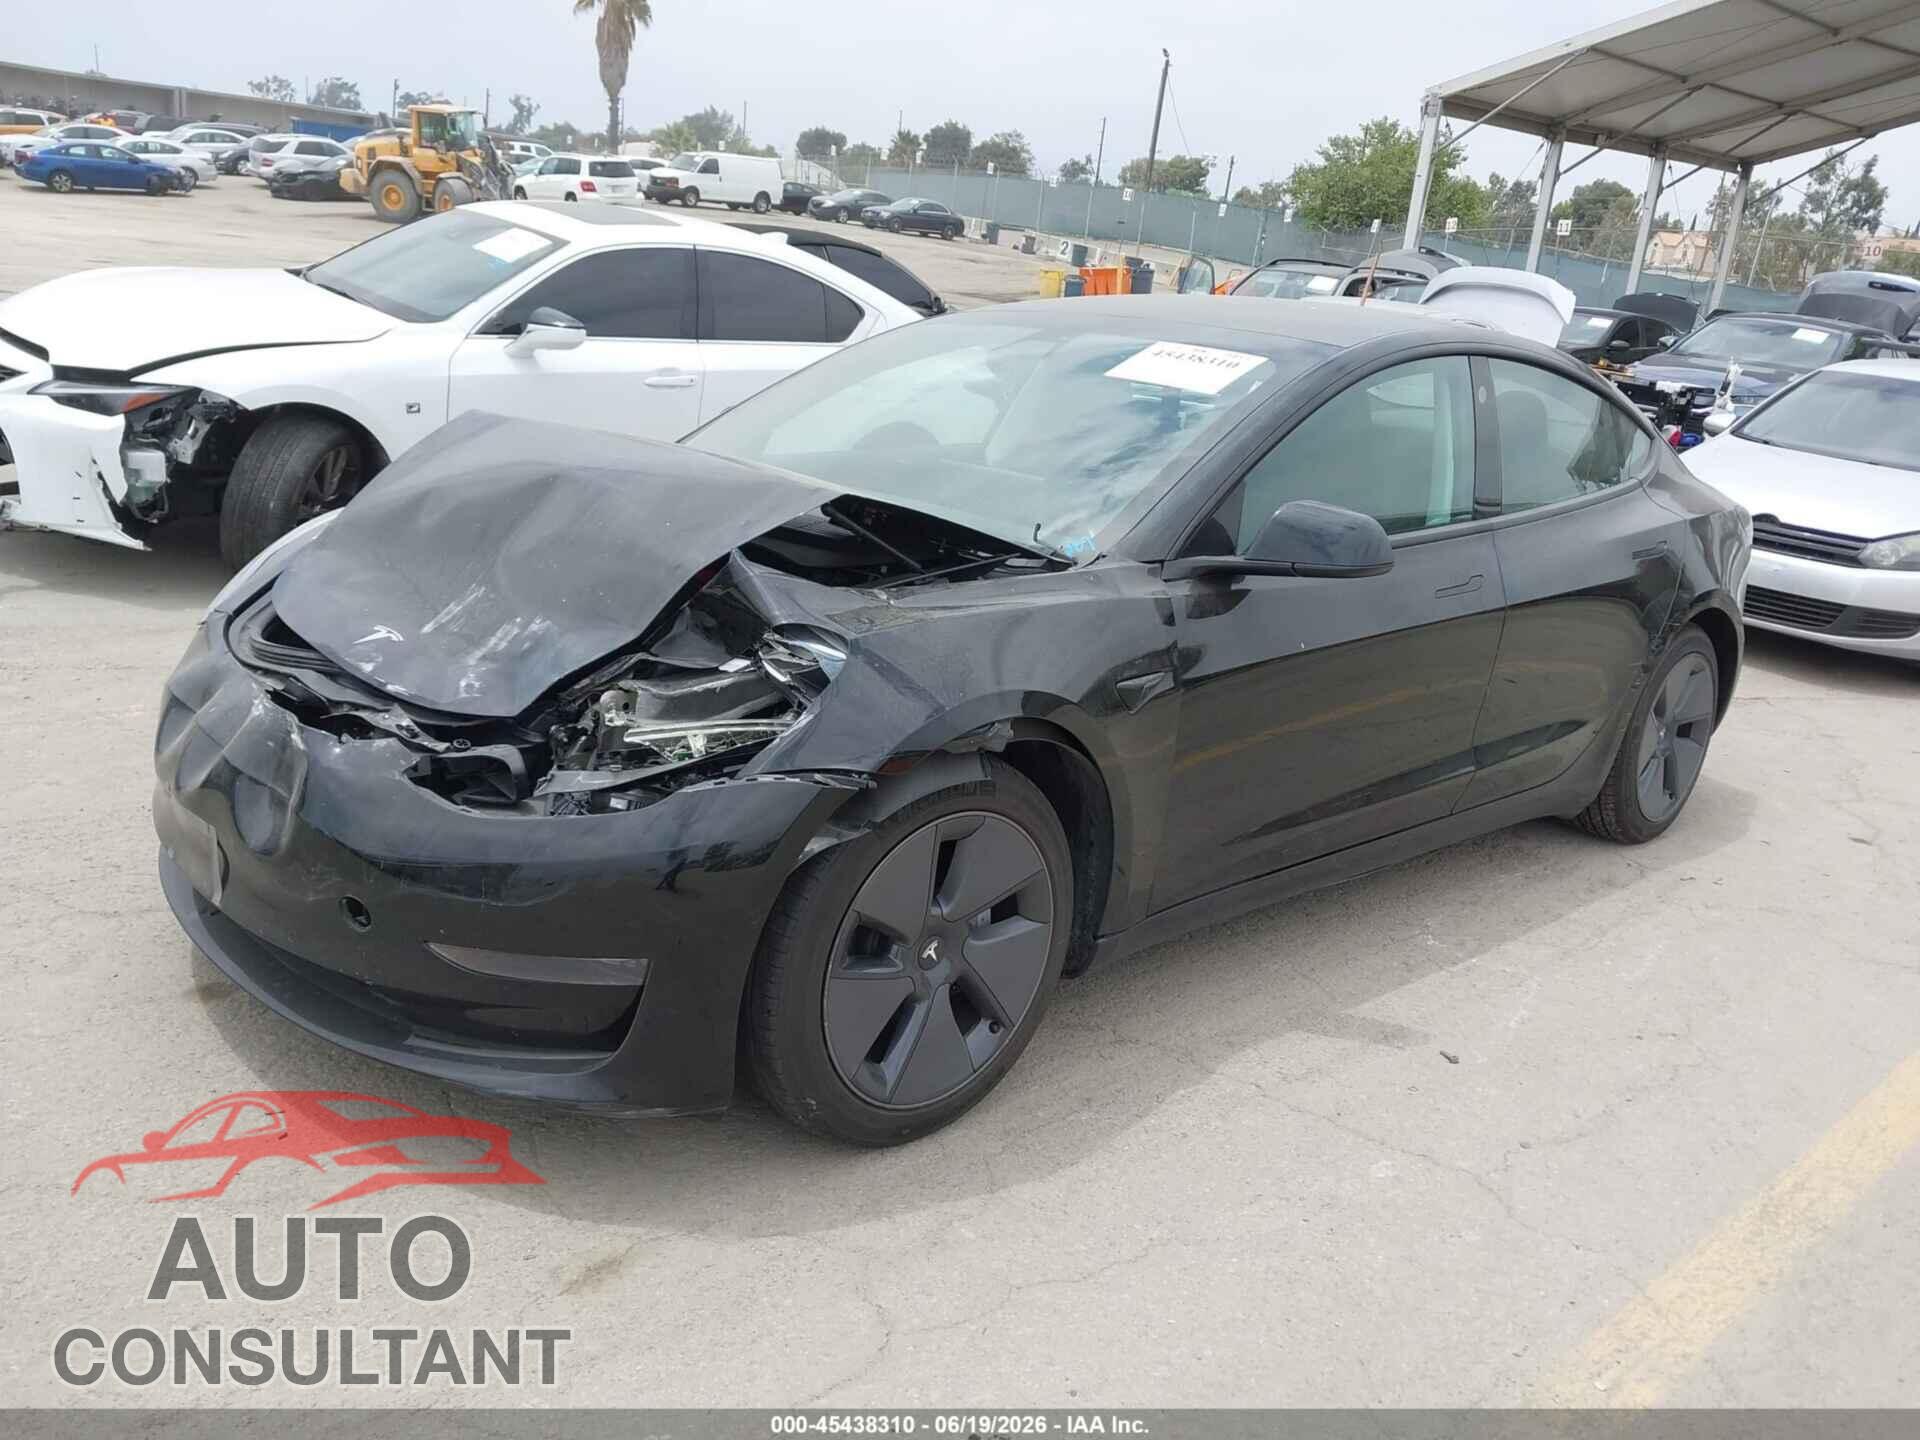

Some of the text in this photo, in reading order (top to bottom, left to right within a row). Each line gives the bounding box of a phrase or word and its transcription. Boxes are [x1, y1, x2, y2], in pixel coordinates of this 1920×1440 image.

[1559, 222, 1570, 233] 11
[1060, 240, 1069, 256] 2
[1864, 246, 1882, 257] 10
